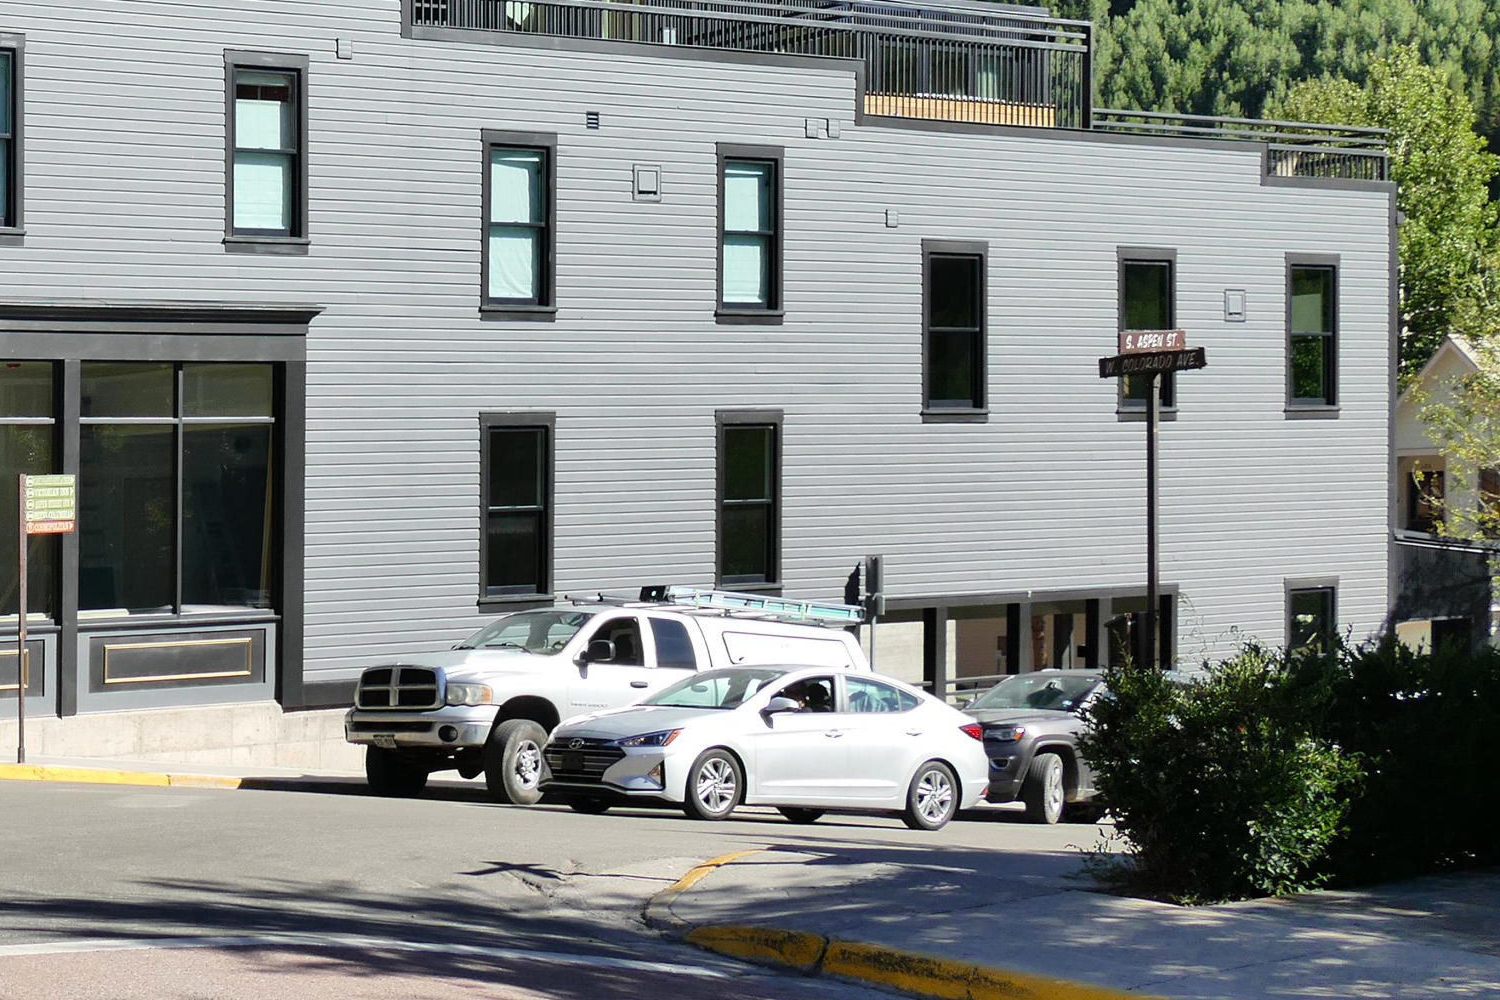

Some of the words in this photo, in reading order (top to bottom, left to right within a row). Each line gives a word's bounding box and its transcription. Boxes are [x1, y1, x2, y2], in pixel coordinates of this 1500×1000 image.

[1125, 334, 1135, 349] S.
[1137, 334, 1164, 349] ASPEN
[1166, 333, 1180, 347] ST.
[1105, 360, 1118, 374] W.
[1121, 355, 1173, 373] COLORADO
[1176, 353, 1200, 368] AVE.
